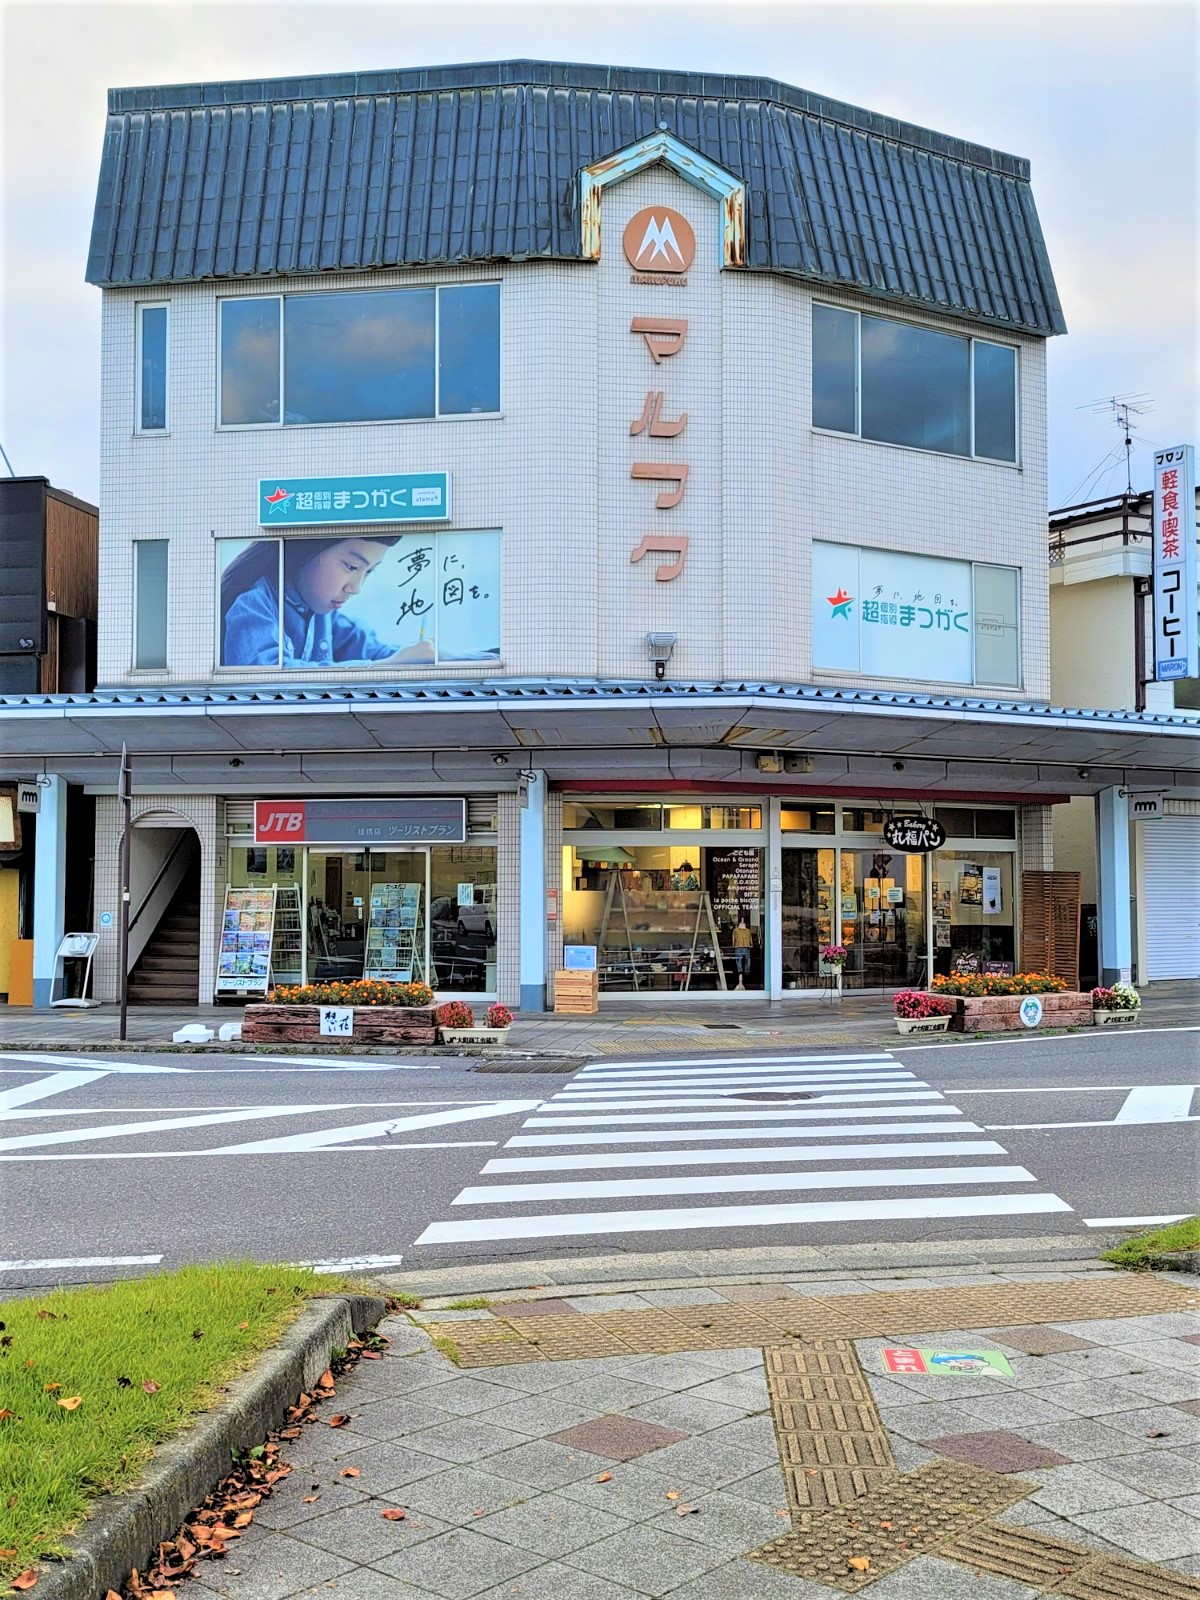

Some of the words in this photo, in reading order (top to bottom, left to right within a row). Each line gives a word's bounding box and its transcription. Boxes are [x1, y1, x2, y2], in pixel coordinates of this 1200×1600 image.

[630, 316, 689, 581] マルフク
[1156, 450, 1184, 465] マロン
[1161, 469, 1179, 560] 軽食・喫茶
[1162, 570, 1181, 657] コーヒー
[259, 812, 303, 832] JTB
[904, 819, 926, 830] Bakery
[892, 828, 941, 848] 丸福パン
